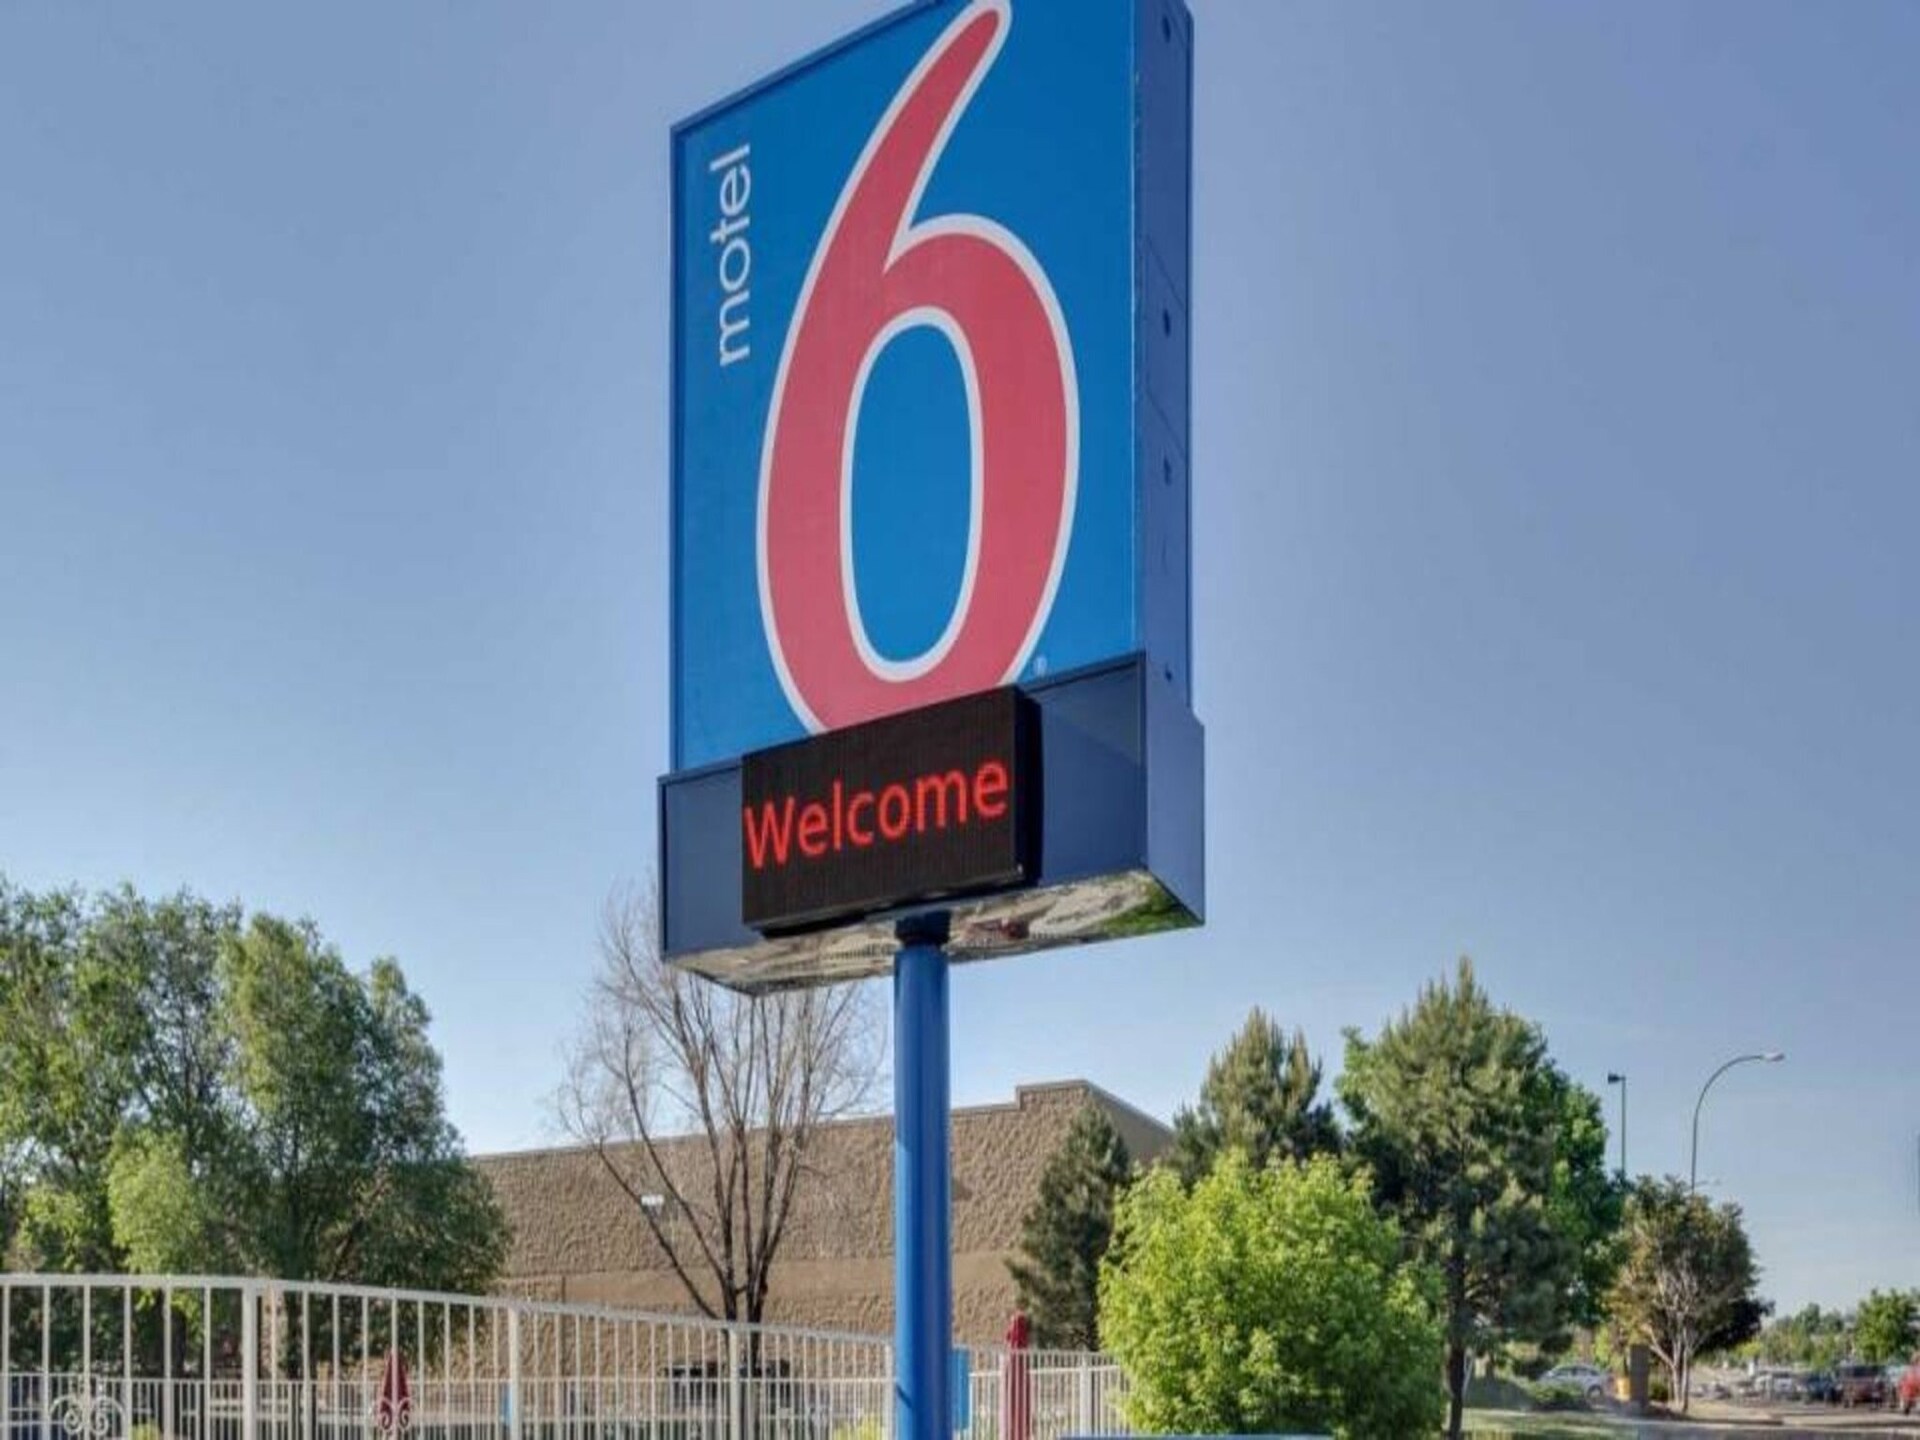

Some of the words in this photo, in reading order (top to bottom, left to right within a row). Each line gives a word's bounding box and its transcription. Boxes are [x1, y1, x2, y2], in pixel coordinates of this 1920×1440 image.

[709, 142, 751, 368] motel
[757, 0, 1080, 735] 6
[743, 759, 1009, 870] Welcome
